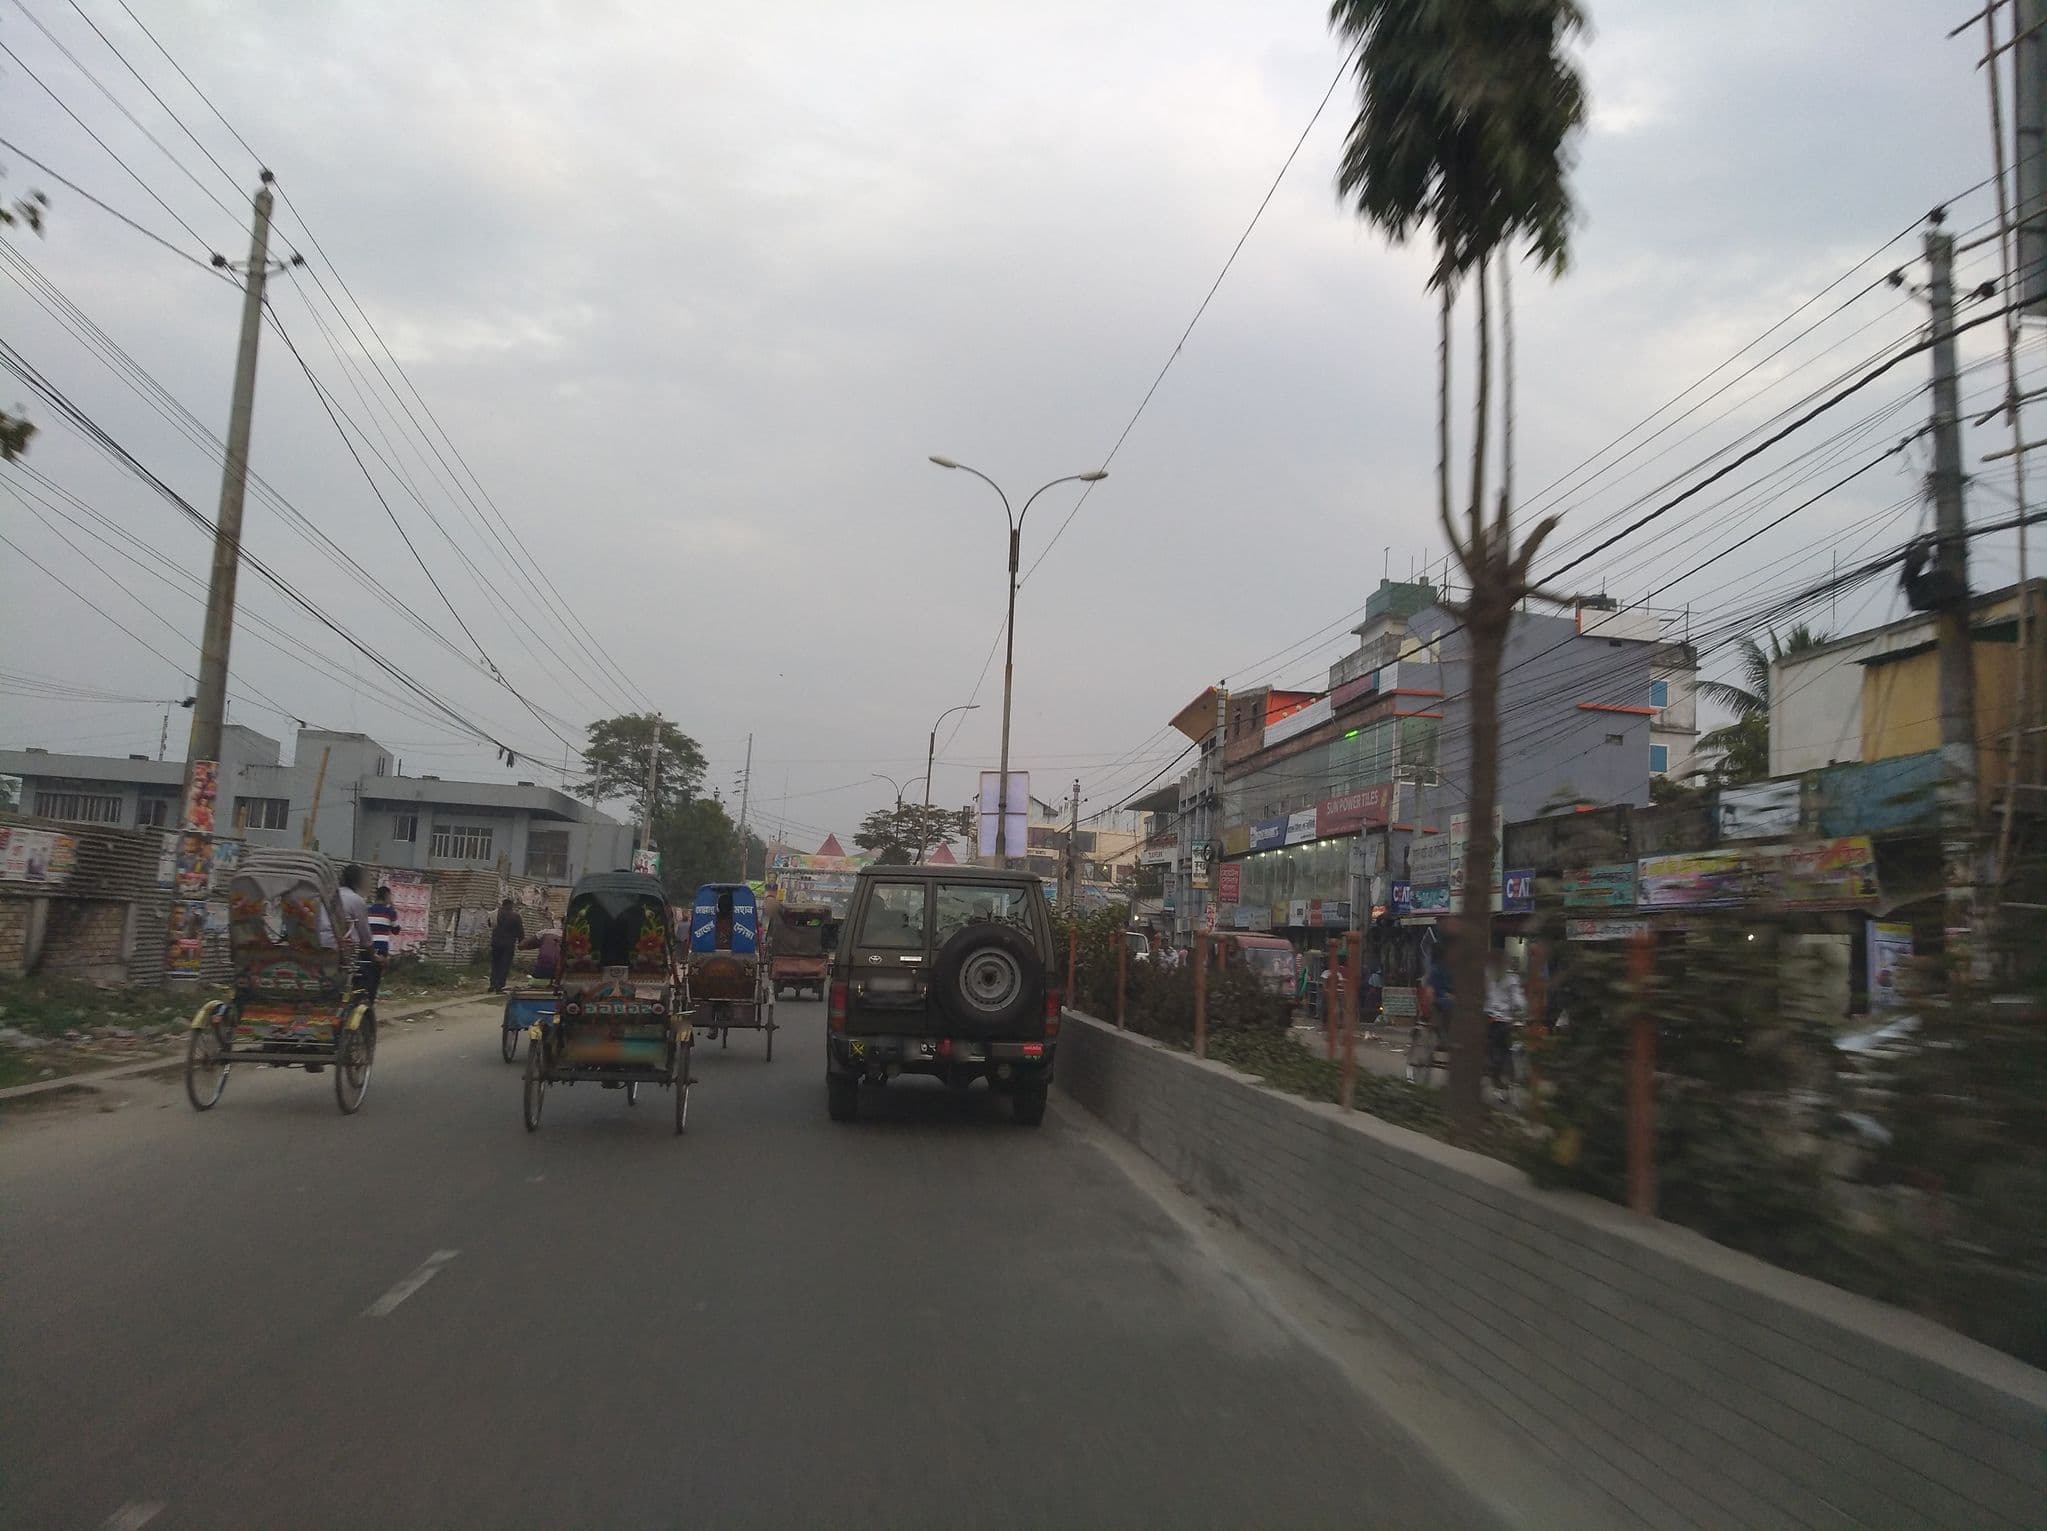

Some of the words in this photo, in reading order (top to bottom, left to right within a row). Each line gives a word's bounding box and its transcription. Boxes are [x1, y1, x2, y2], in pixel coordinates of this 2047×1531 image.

[1327, 802, 1339, 815] SUN
[1340, 793, 1361, 812] POWER
[1361, 790, 1379, 808] TILES
[1507, 877, 1532, 899] CEAT
